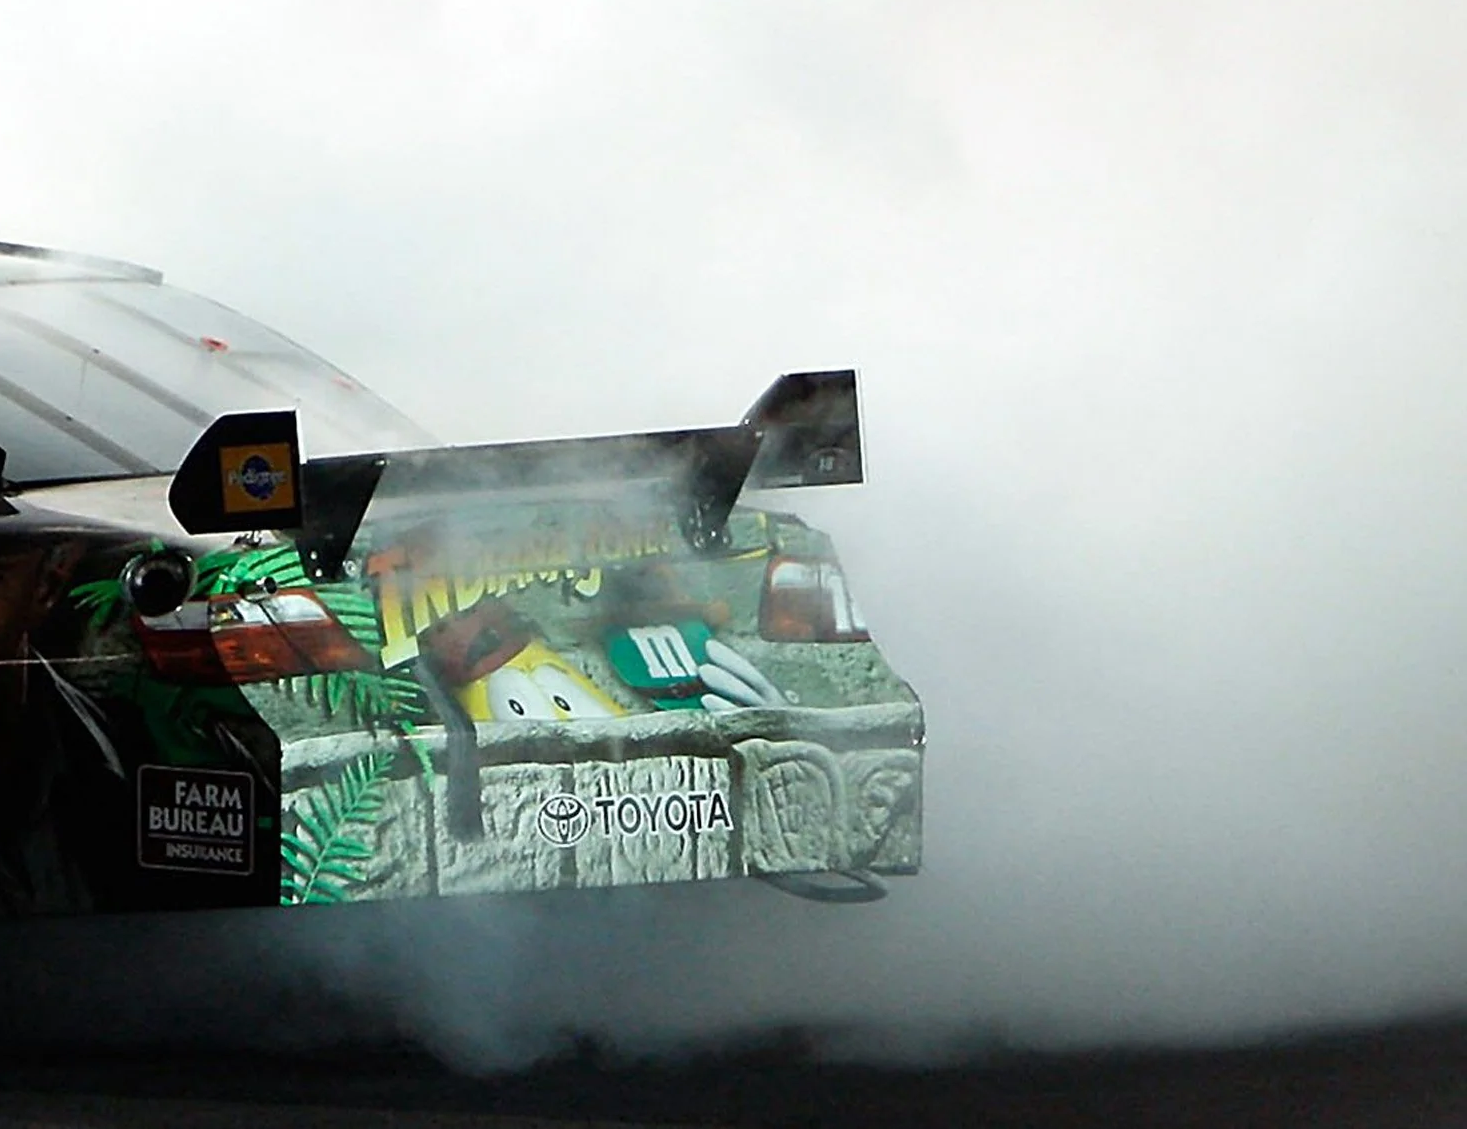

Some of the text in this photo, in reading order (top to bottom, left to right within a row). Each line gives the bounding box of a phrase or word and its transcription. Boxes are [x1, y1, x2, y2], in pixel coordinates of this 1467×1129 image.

[175, 780, 243, 810] FARM
[148, 805, 244, 837] BUREAU
[594, 791, 733, 837] TOYOTA
[165, 842, 244, 863] INSURANCE
